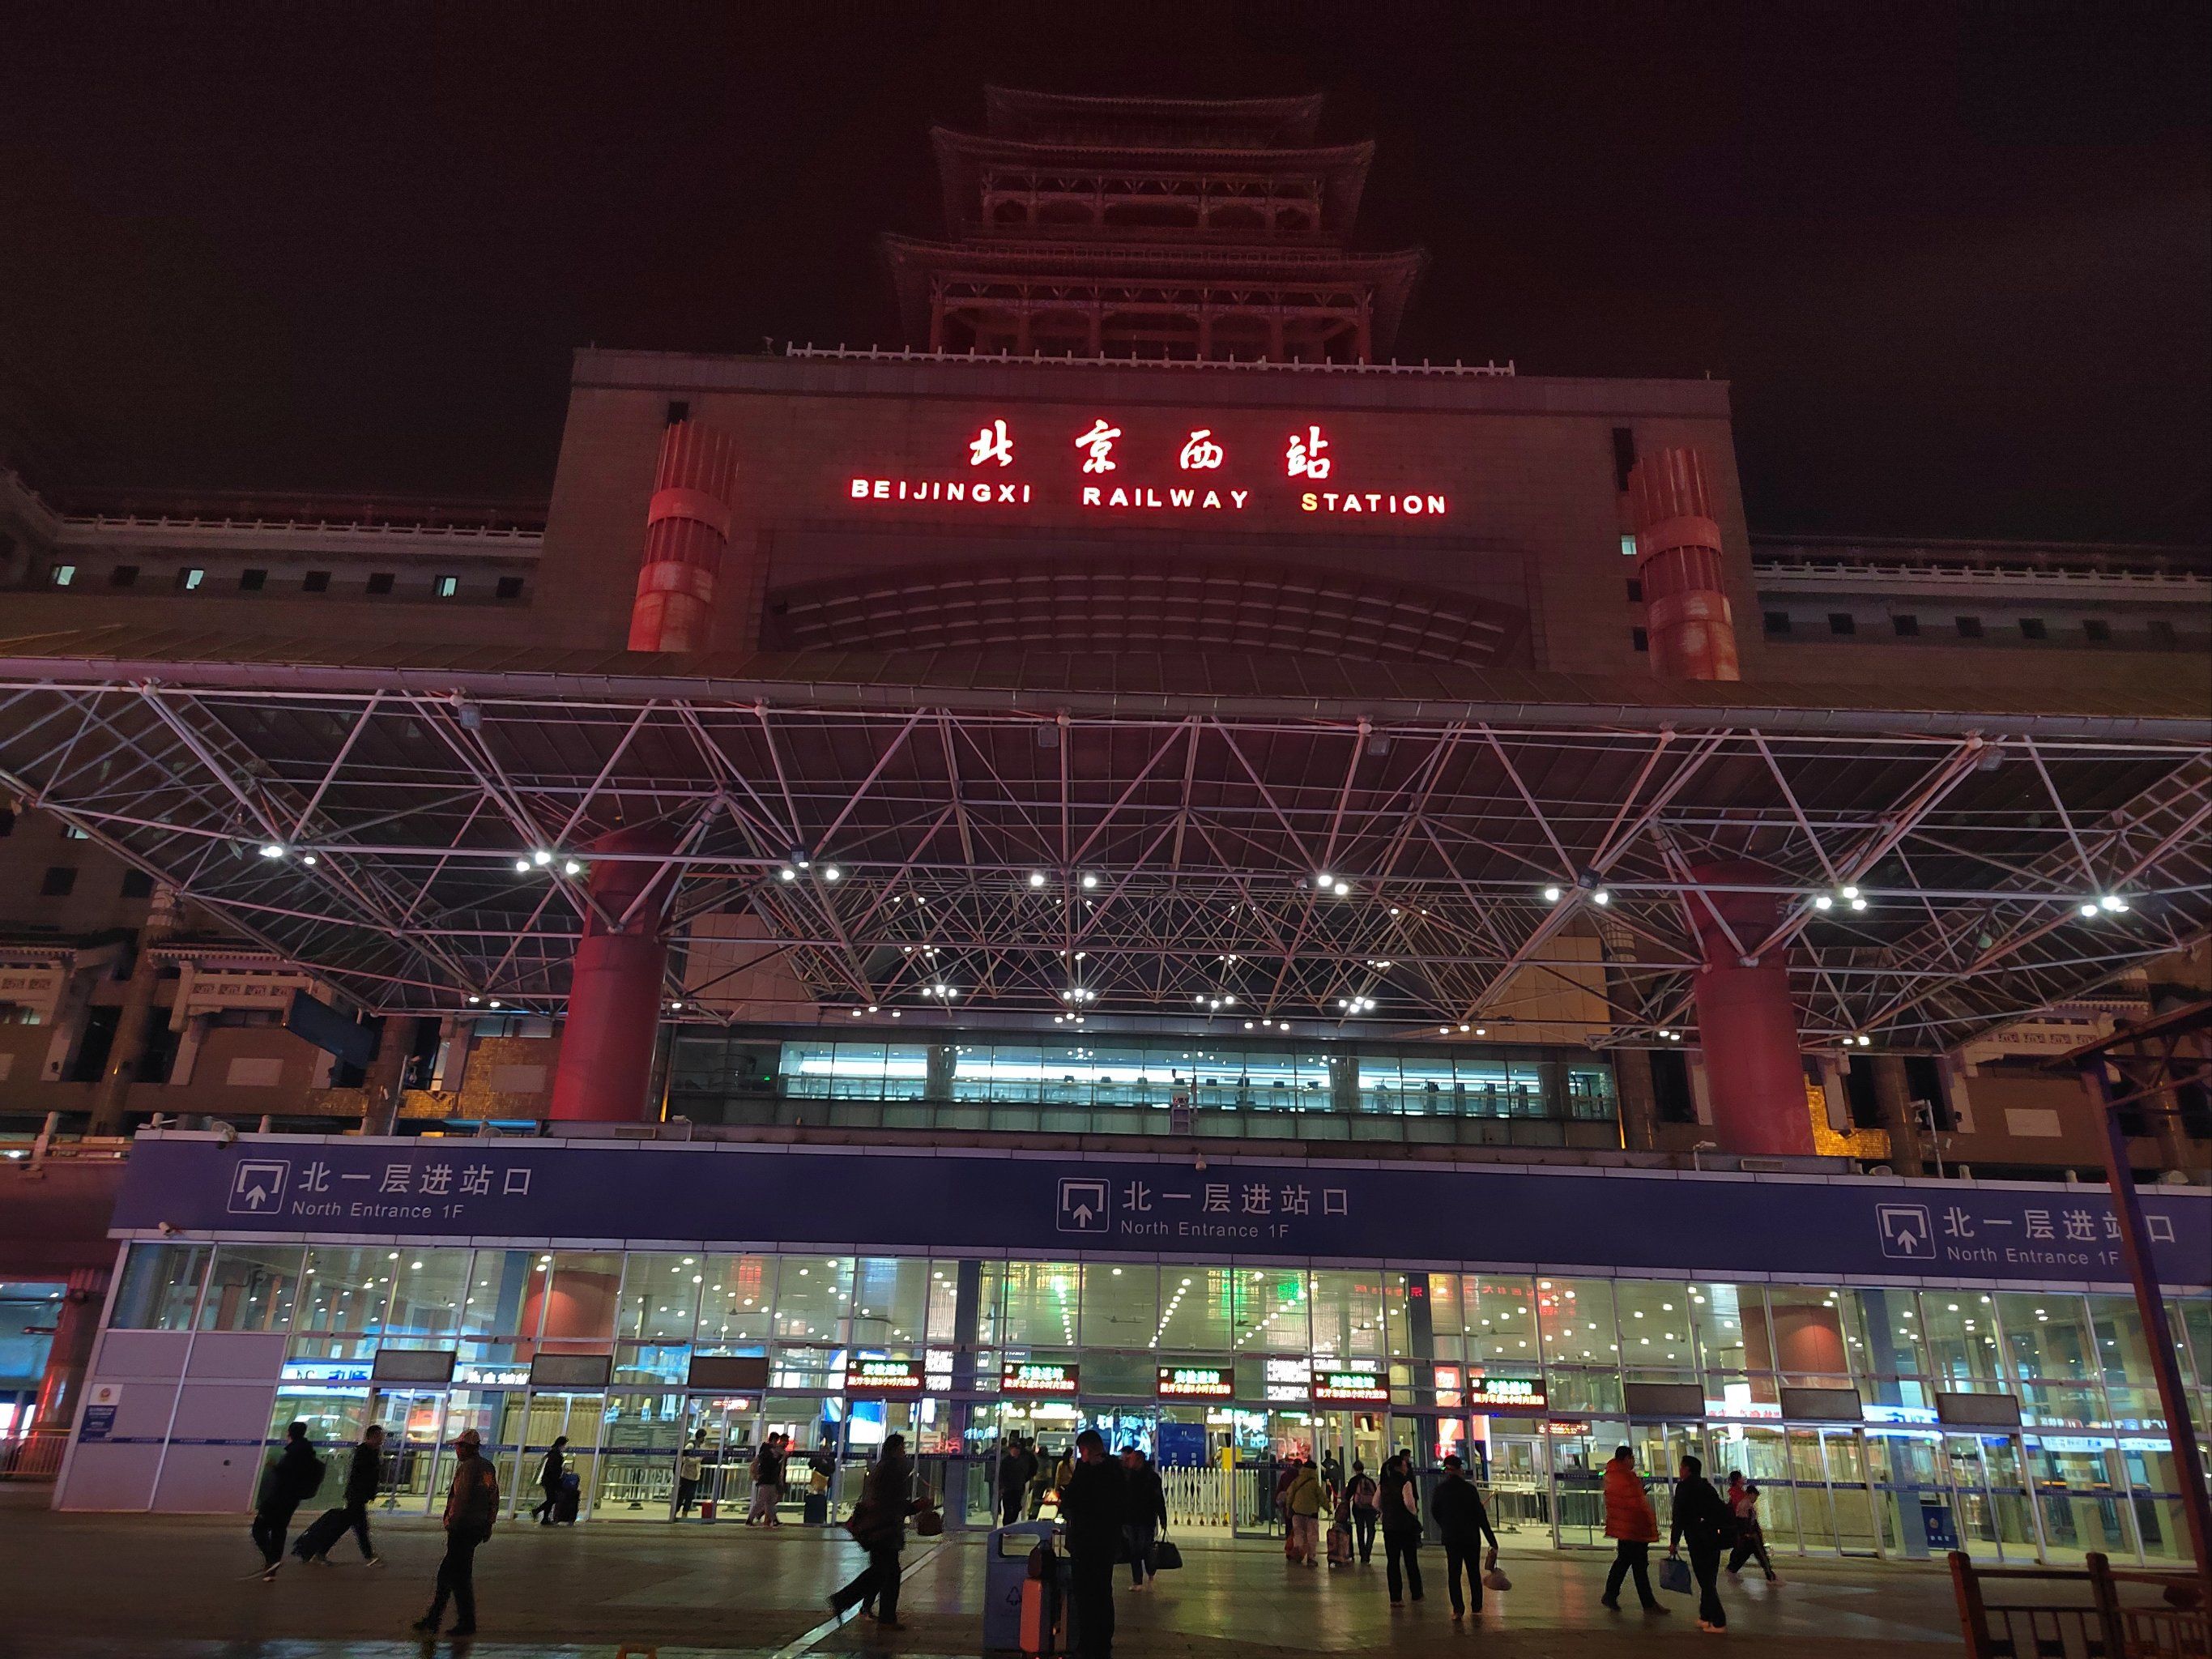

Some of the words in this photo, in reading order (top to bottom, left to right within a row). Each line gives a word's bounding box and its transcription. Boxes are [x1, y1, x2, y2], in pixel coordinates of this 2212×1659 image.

[970, 420, 1330, 478] 北京西站
[852, 480, 1029, 502] BEIJINGXI
[1084, 488, 1247, 508] RAILWAY
[1302, 493, 1444, 514] STATION
[299, 1162, 532, 1195] 北一层进站口
[292, 1201, 341, 1217] North
[350, 1202, 432, 1219] Entrance
[443, 1204, 464, 1220] 1F
[1122, 1182, 1347, 1215] 北一层进站口
[1121, 1220, 1169, 1235] North
[1178, 1222, 1258, 1239] Entrance
[1269, 1224, 1289, 1239] 1F
[1947, 1246, 1997, 1262] North
[2005, 1247, 2088, 1265] Entrance
[2098, 1251, 2119, 1266] 1F
